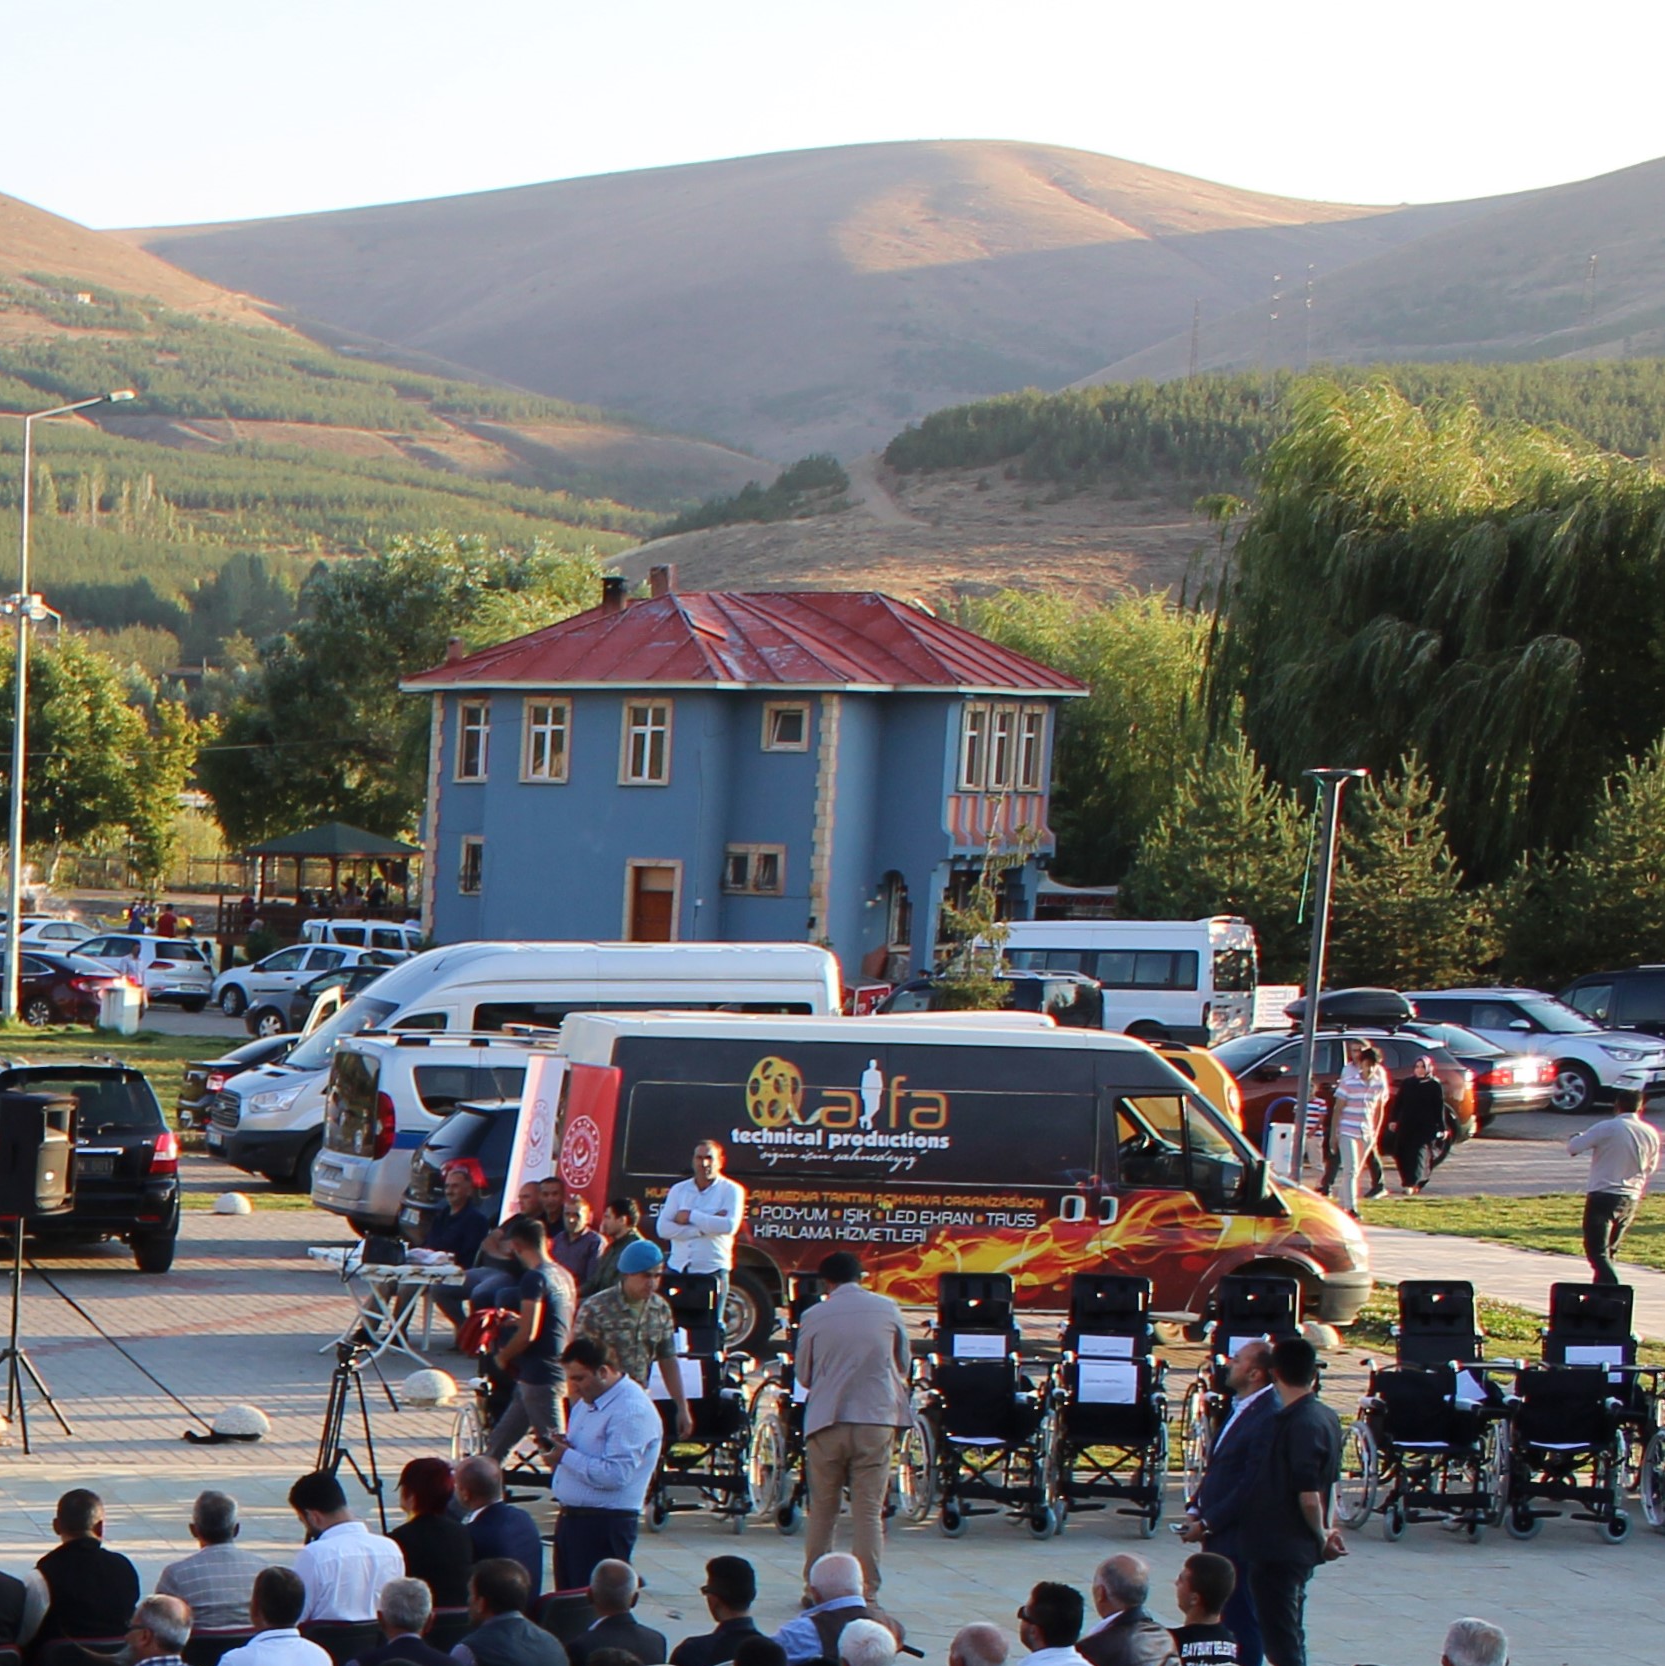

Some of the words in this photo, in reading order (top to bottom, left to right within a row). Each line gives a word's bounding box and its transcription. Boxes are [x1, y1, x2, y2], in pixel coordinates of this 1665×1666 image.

[731, 1127, 823, 1146] technical
[828, 1129, 951, 1150] productions
[905, 1194, 942, 1206] HAVA
[942, 1194, 1045, 1209] ORGANİZASYON
[760, 1205, 828, 1221] PODYUM
[842, 1207, 871, 1225] IŞIK
[885, 1209, 918, 1225] LED
[919, 1210, 974, 1226] EKRAN
[985, 1212, 1037, 1228] TRUSS
[753, 1222, 833, 1240] KİRALAMA
[835, 1225, 927, 1243] HİZMETLERİ
